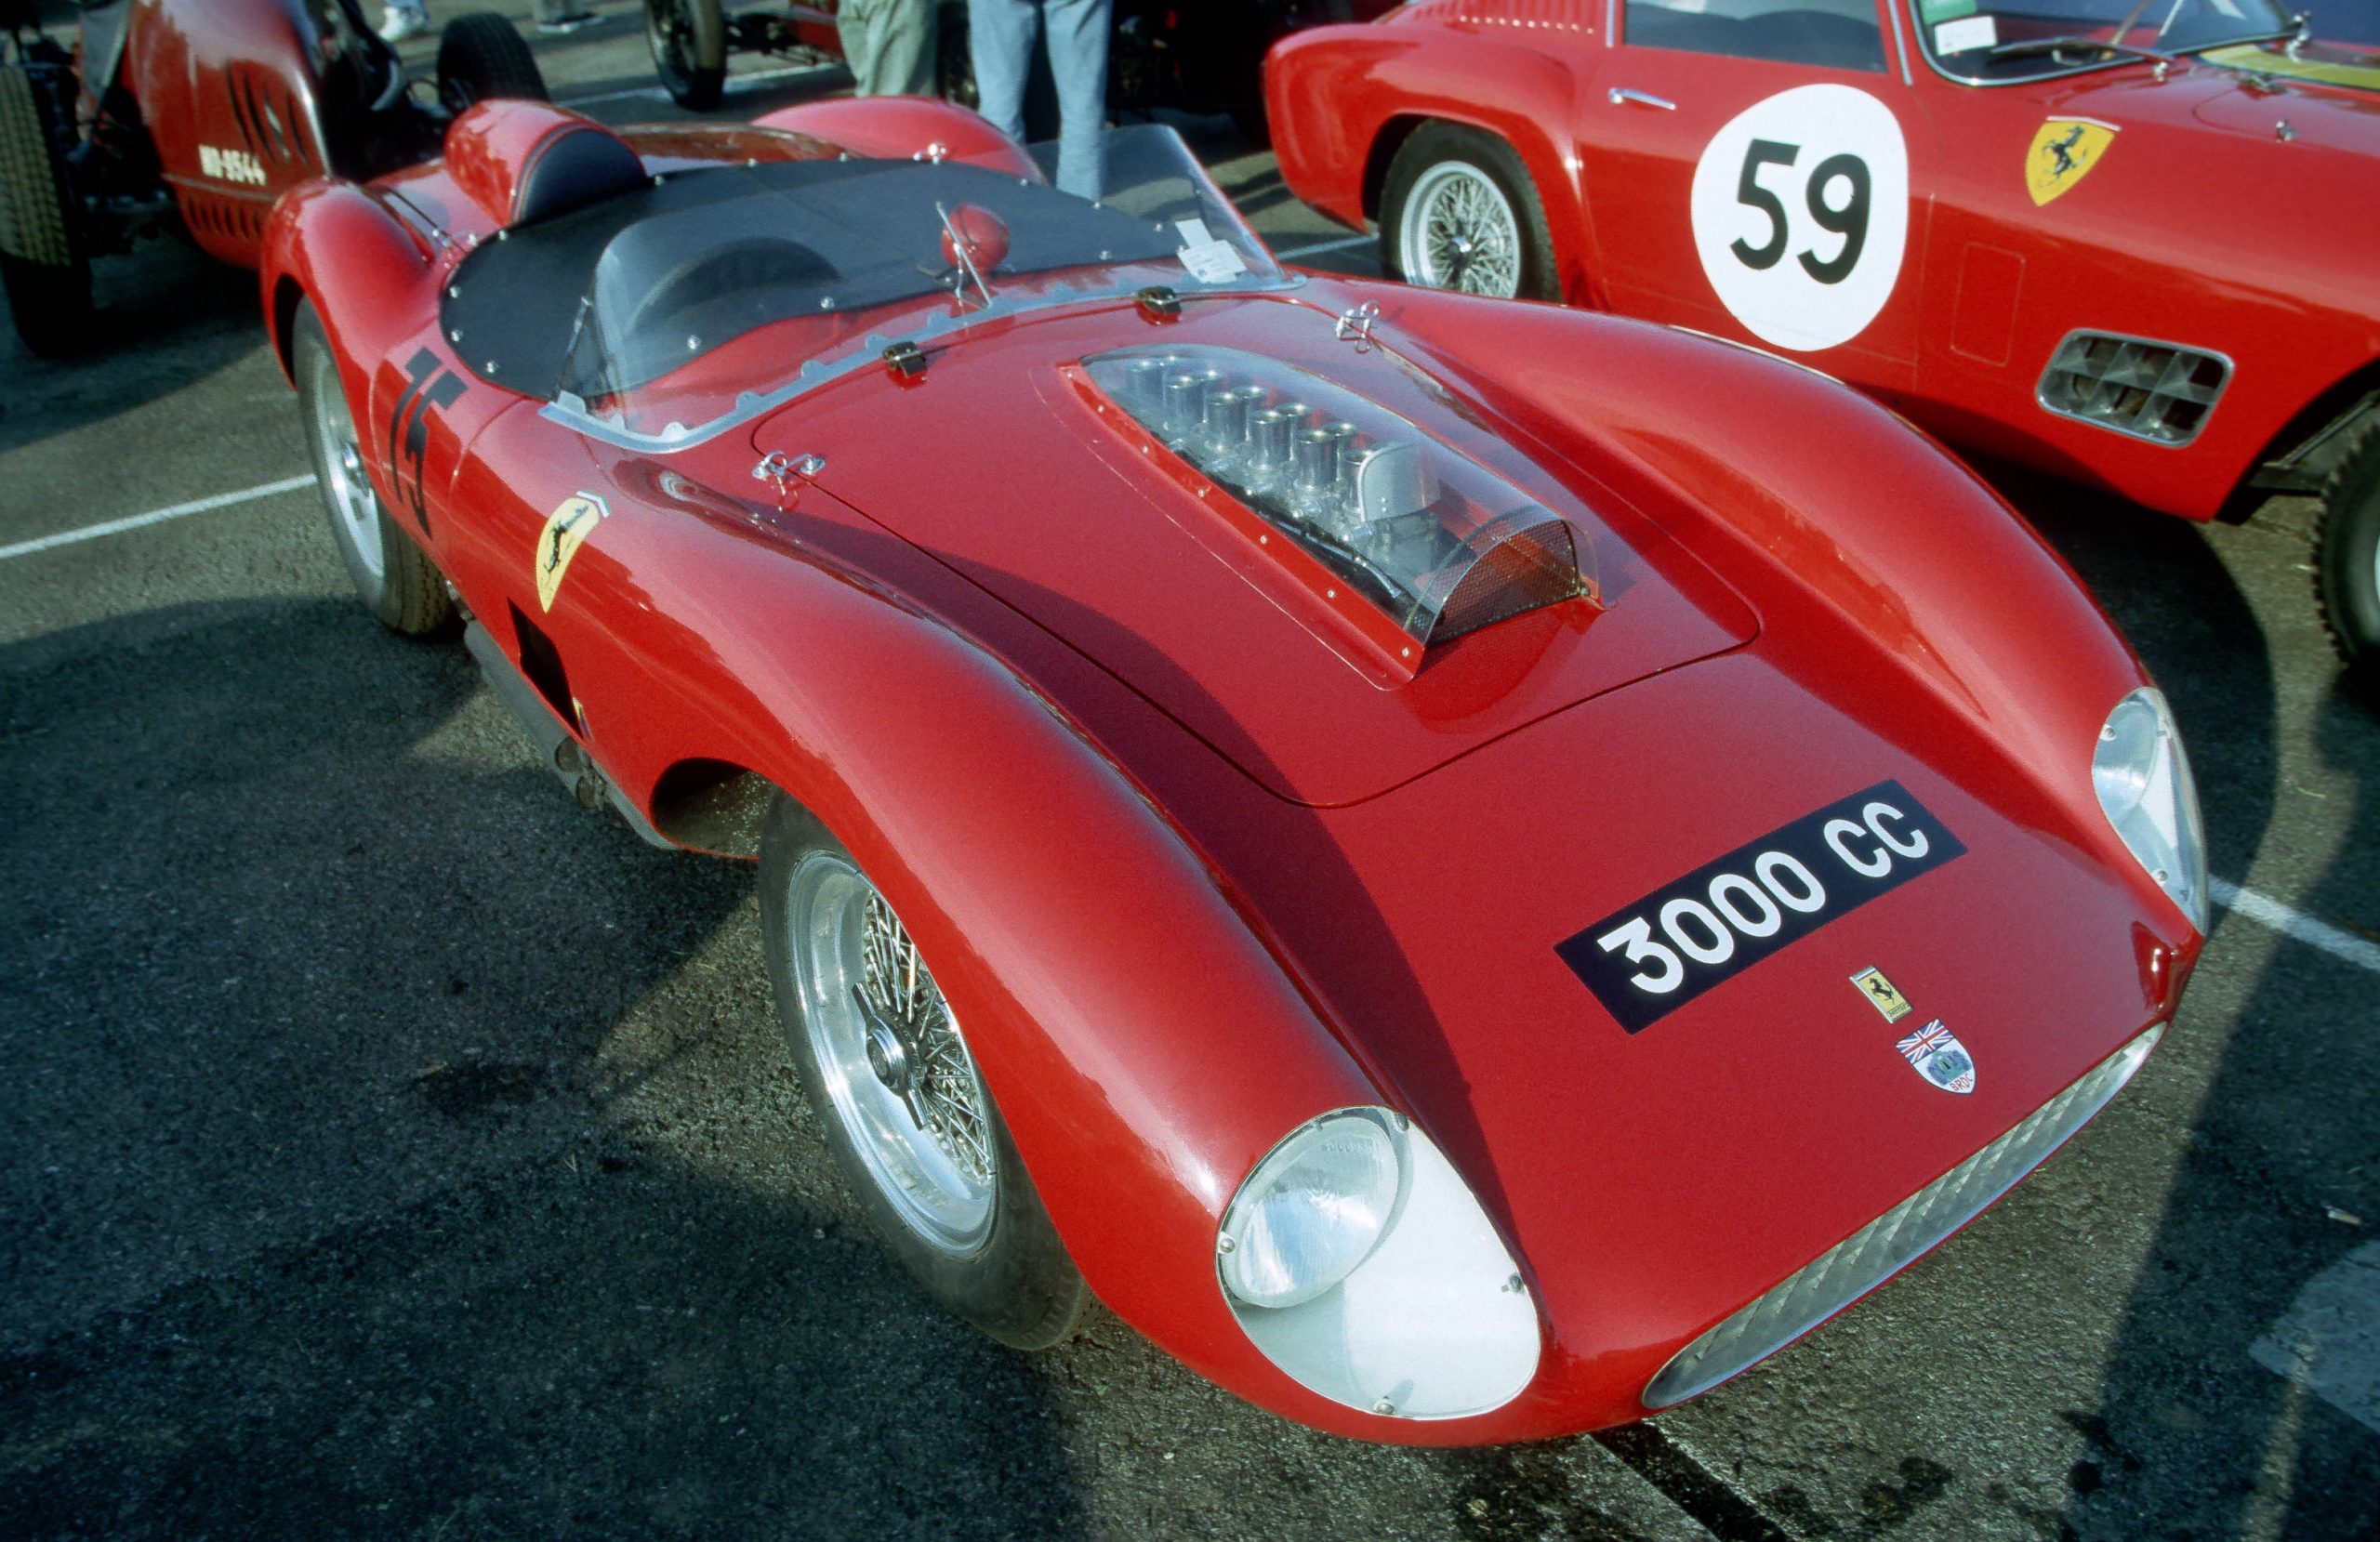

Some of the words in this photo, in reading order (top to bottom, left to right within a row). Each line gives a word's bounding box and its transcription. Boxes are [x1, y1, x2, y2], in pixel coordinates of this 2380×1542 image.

[1729, 138, 1871, 285] 59
[1596, 850, 1826, 995] 3000
[1823, 801, 1929, 877] CC
[1950, 1073, 1973, 1091] BRDC
